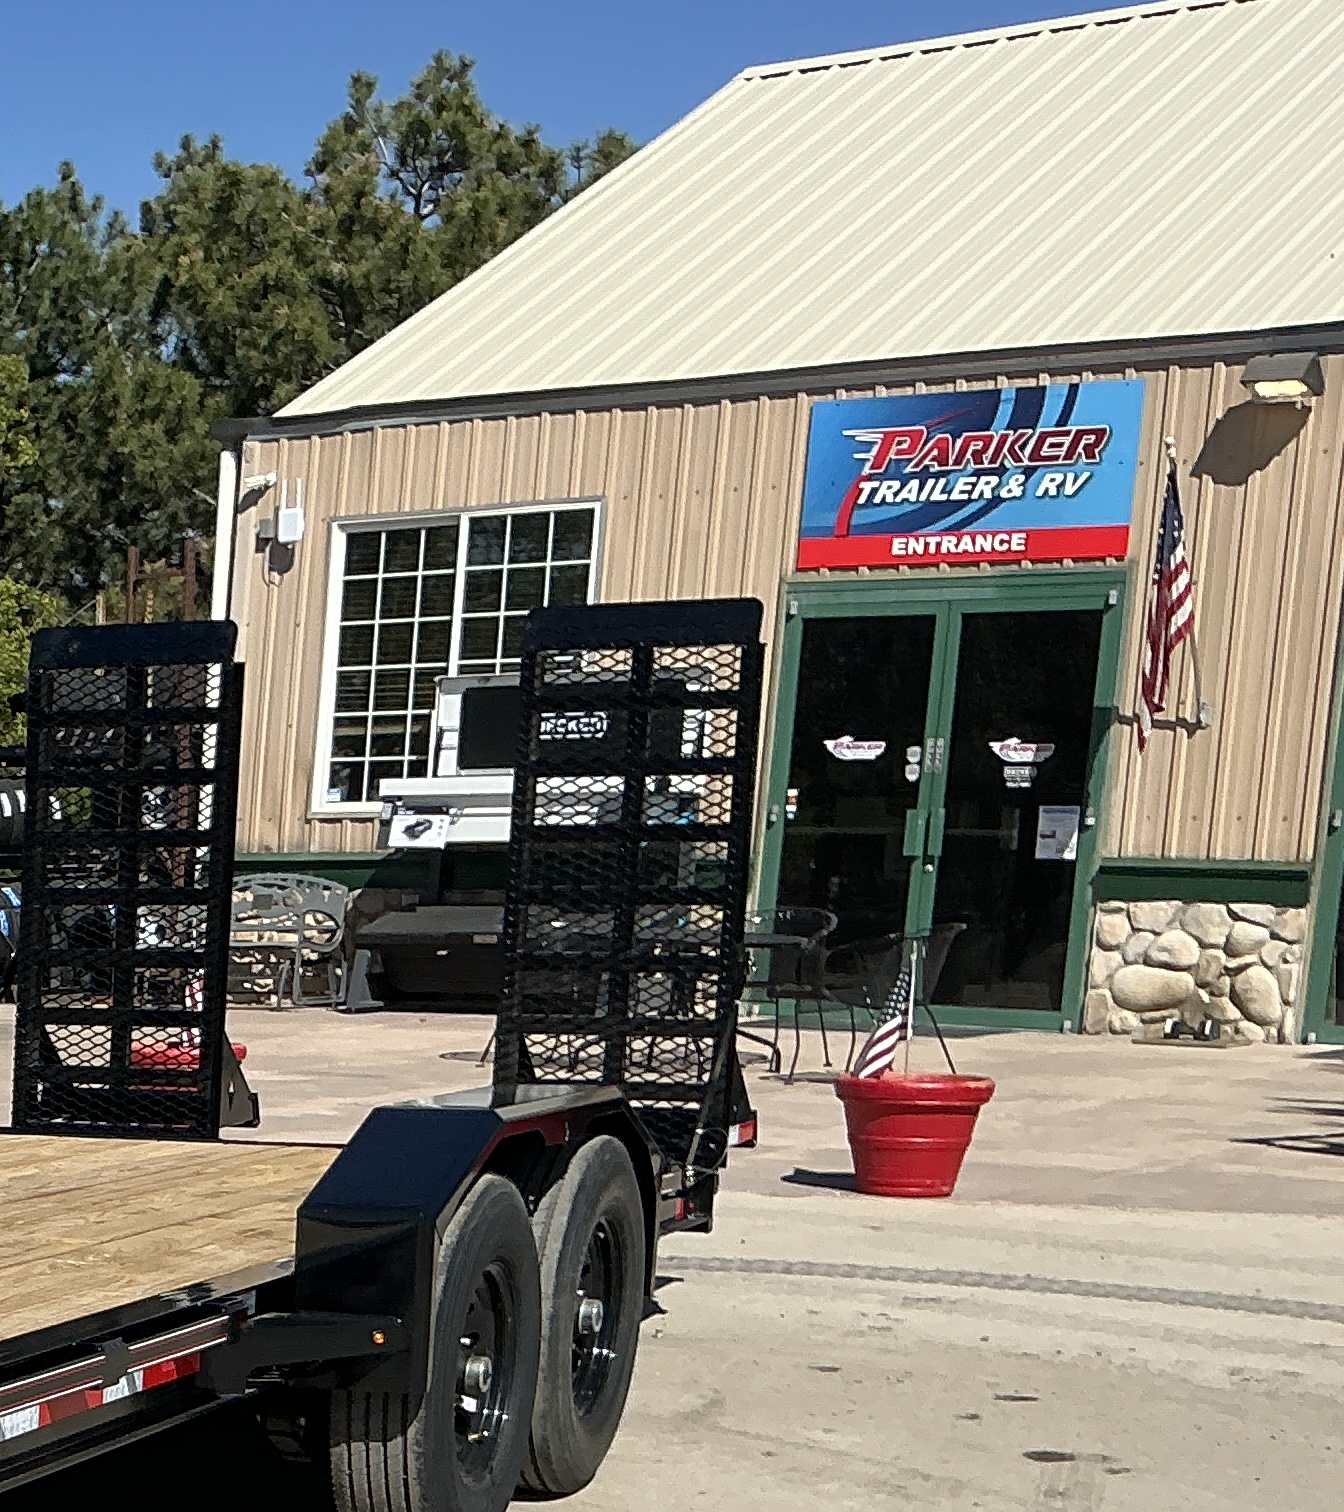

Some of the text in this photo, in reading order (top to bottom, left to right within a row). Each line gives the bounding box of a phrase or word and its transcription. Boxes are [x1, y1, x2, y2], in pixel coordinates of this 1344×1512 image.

[842, 425, 1111, 474] PARKER
[856, 471, 1092, 505] TRAILER & RV
[890, 531, 1028, 557] ENTRANCE
